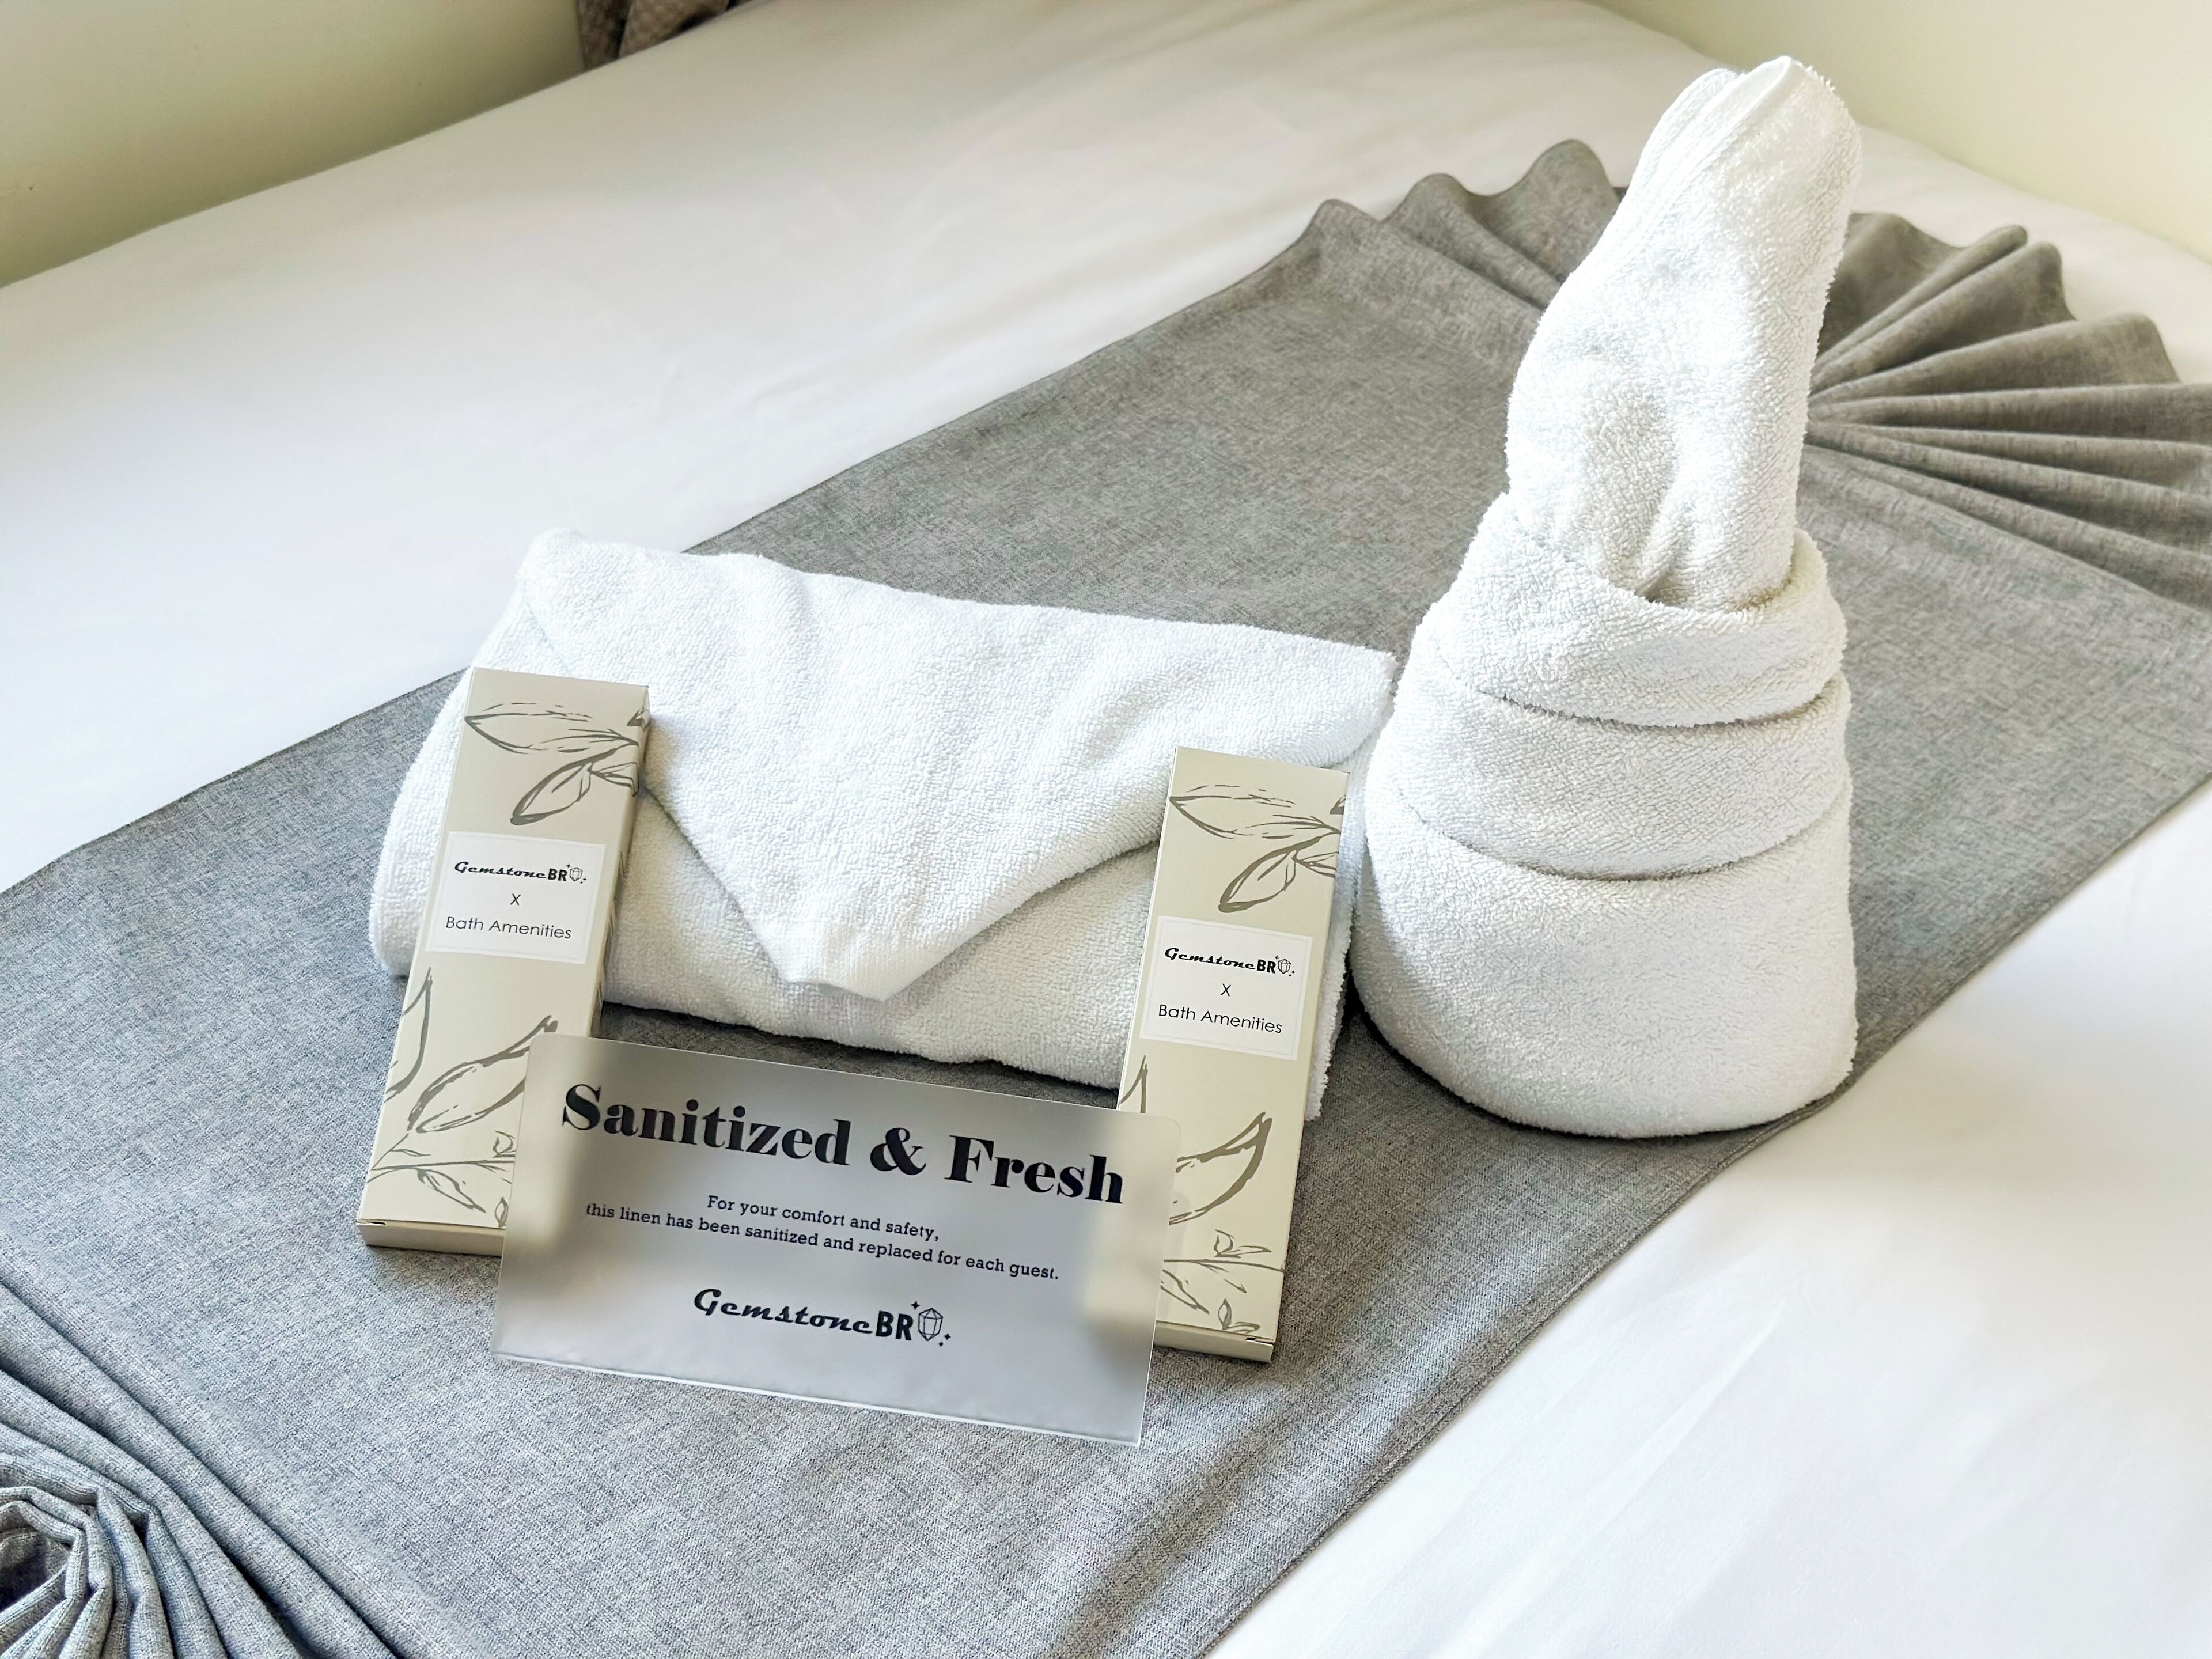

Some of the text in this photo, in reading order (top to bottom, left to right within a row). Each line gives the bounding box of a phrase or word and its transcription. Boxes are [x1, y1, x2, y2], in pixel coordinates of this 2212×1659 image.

[445, 916, 572, 940] Bath Amenities
[1158, 1003, 1282, 1034] Bath Amenities
[562, 1083, 1123, 1205] Sanitized & Fresh
[586, 1202, 1059, 1281] this linen has been sanitized and replaced for each guest.
[707, 1195, 939, 1242] For your comfort and safety,
